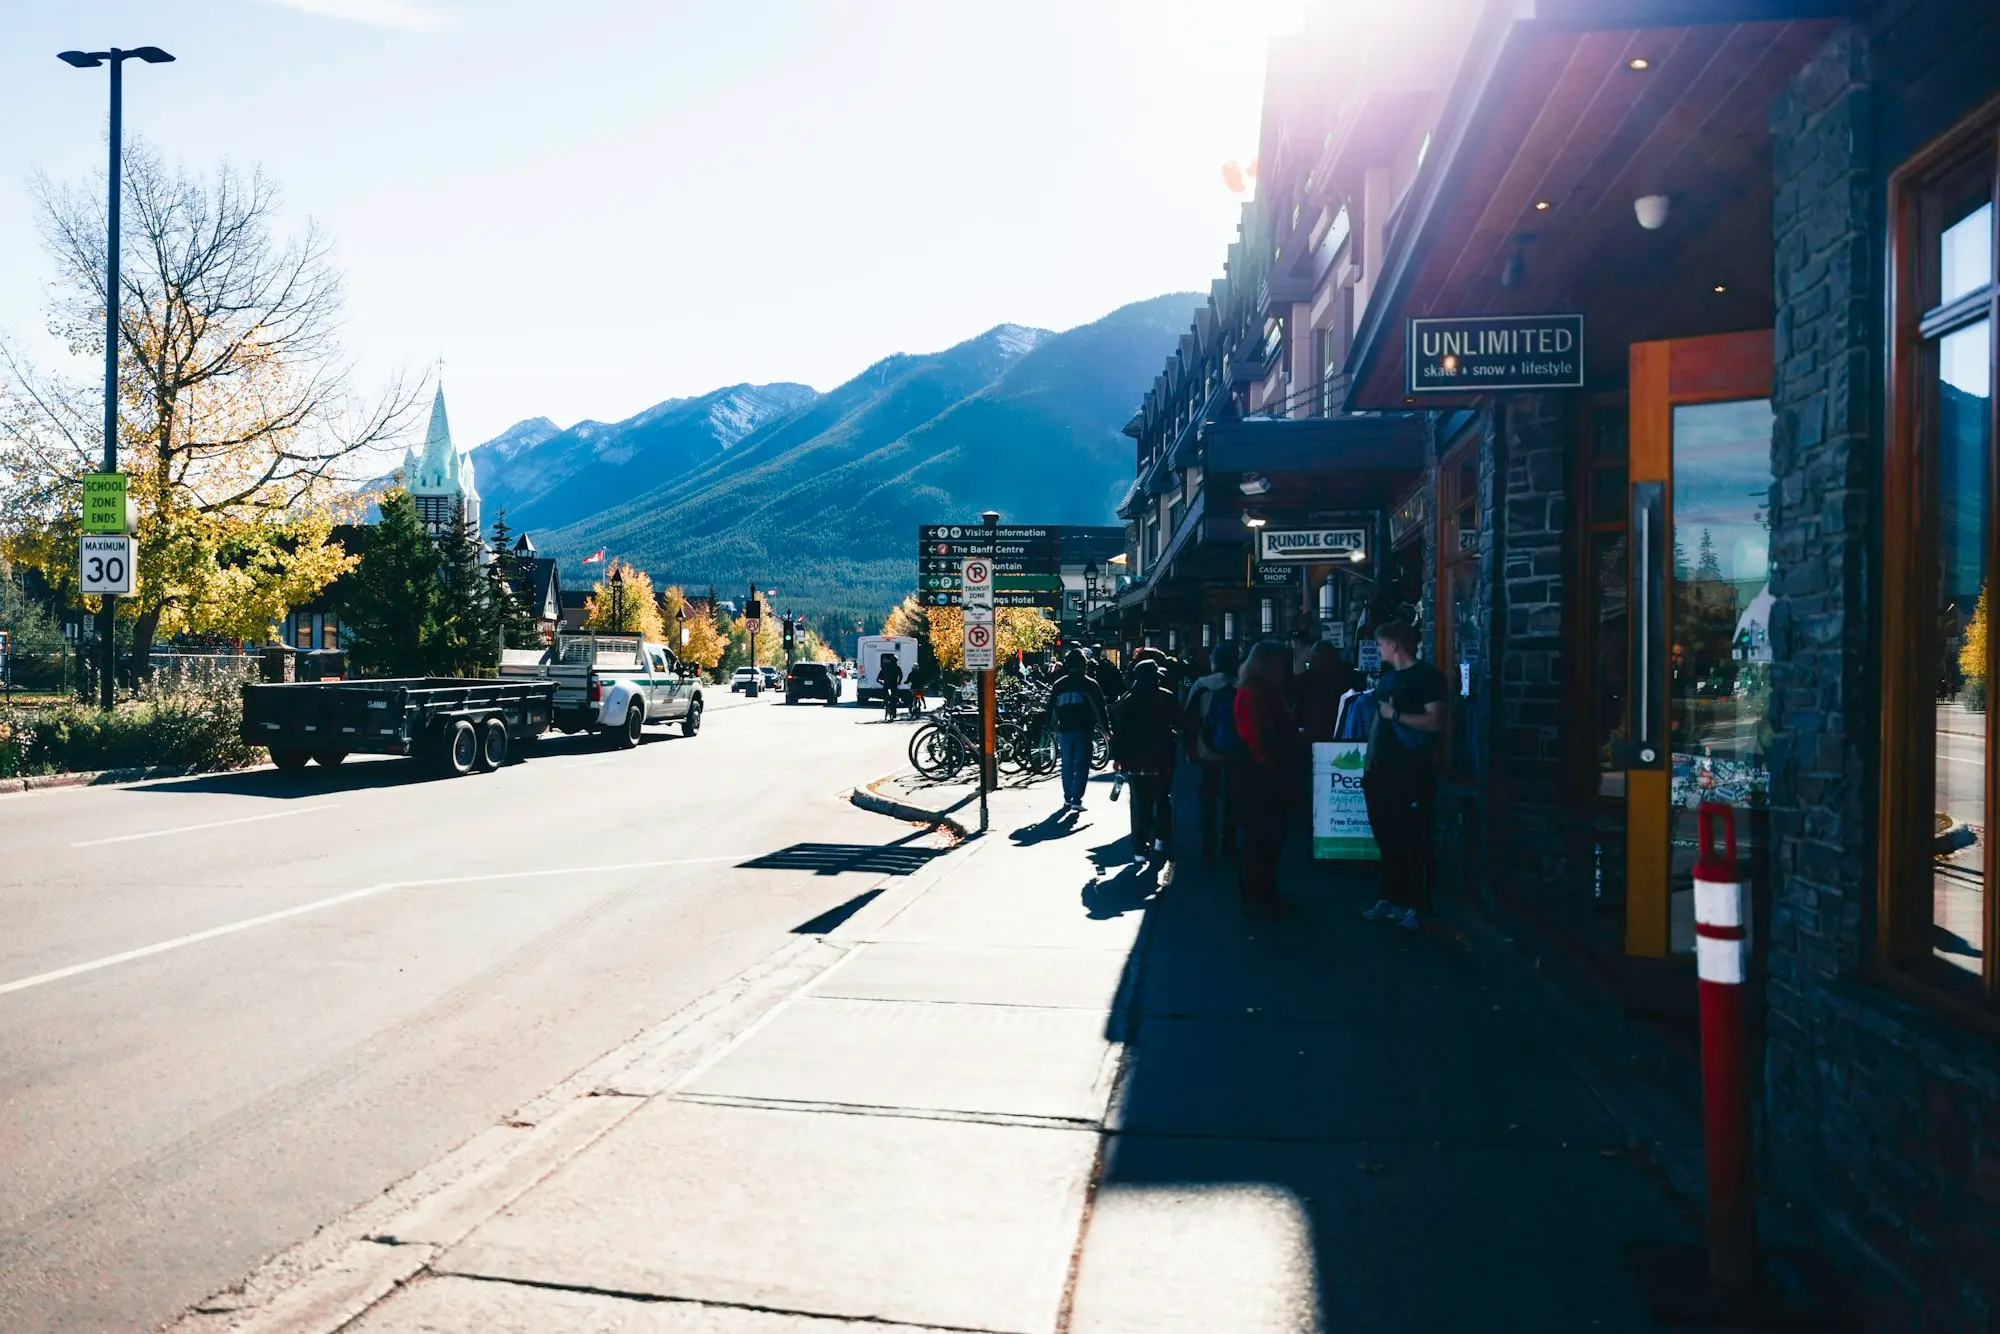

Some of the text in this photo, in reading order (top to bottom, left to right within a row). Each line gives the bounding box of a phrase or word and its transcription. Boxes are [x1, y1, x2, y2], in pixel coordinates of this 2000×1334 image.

[1423, 328, 1572, 356] UNLIMITED
[1472, 365, 1505, 376] snow
[1521, 360, 1572, 377] lifestyle
[86, 481, 123, 492] SCHOOL
[91, 497, 116, 508] ZONE
[91, 513, 116, 524] ENDS
[965, 528, 1046, 537] Visitor Information
[85, 541, 125, 551] MAXIMUM
[1267, 532, 1361, 550] RUNDLE GIFTS
[952, 545, 1025, 554] The Banff Centre
[86, 557, 124, 583] 30
[991, 562, 1022, 570] ountain
[1259, 566, 1292, 574] CASCADE
[1011, 596, 1035, 604] Hotel
[1331, 773, 1363, 789] Pea
